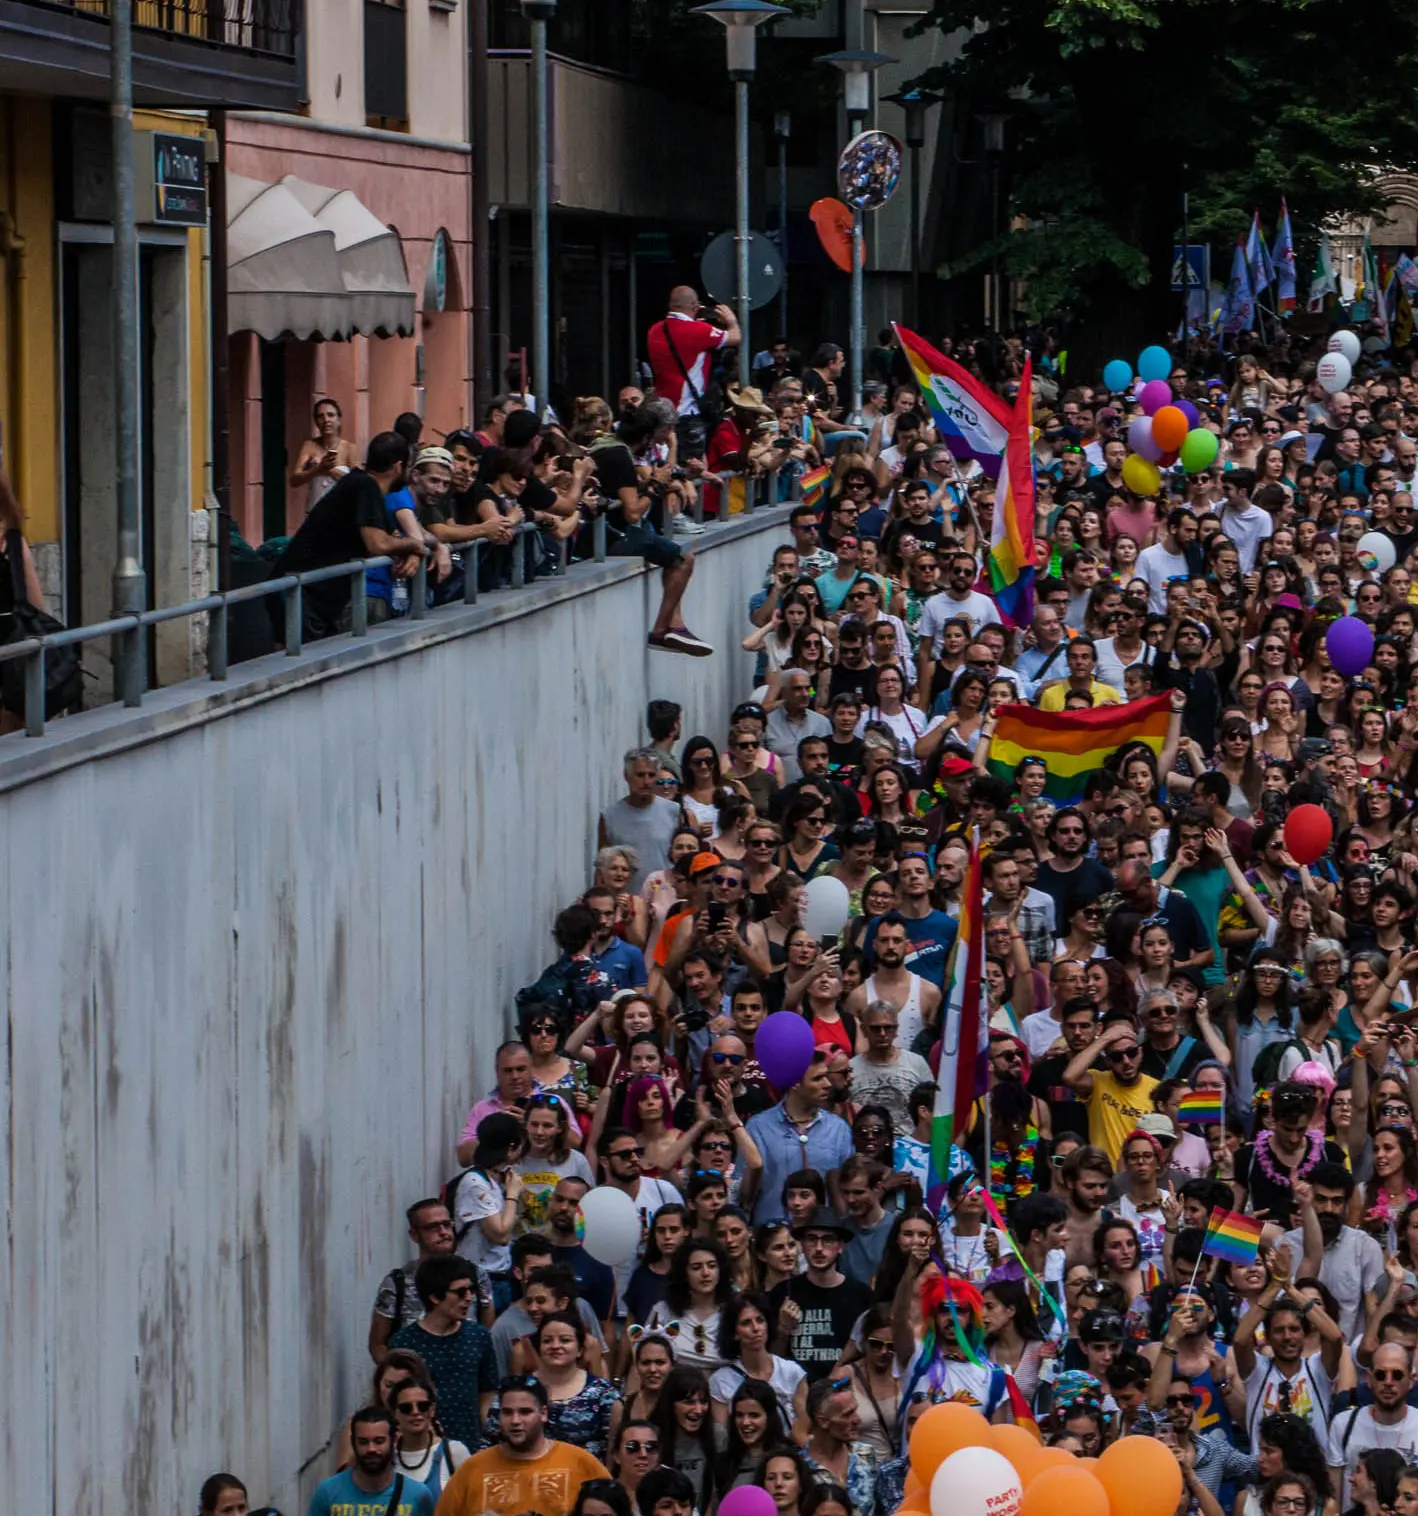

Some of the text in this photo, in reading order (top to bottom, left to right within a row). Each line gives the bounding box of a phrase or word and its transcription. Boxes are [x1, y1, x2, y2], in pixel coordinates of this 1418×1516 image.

[805, 1309, 832, 1322] ALLA
[792, 1322, 835, 1336] UERRA,
[330, 1503, 413, 1516] OREGN
